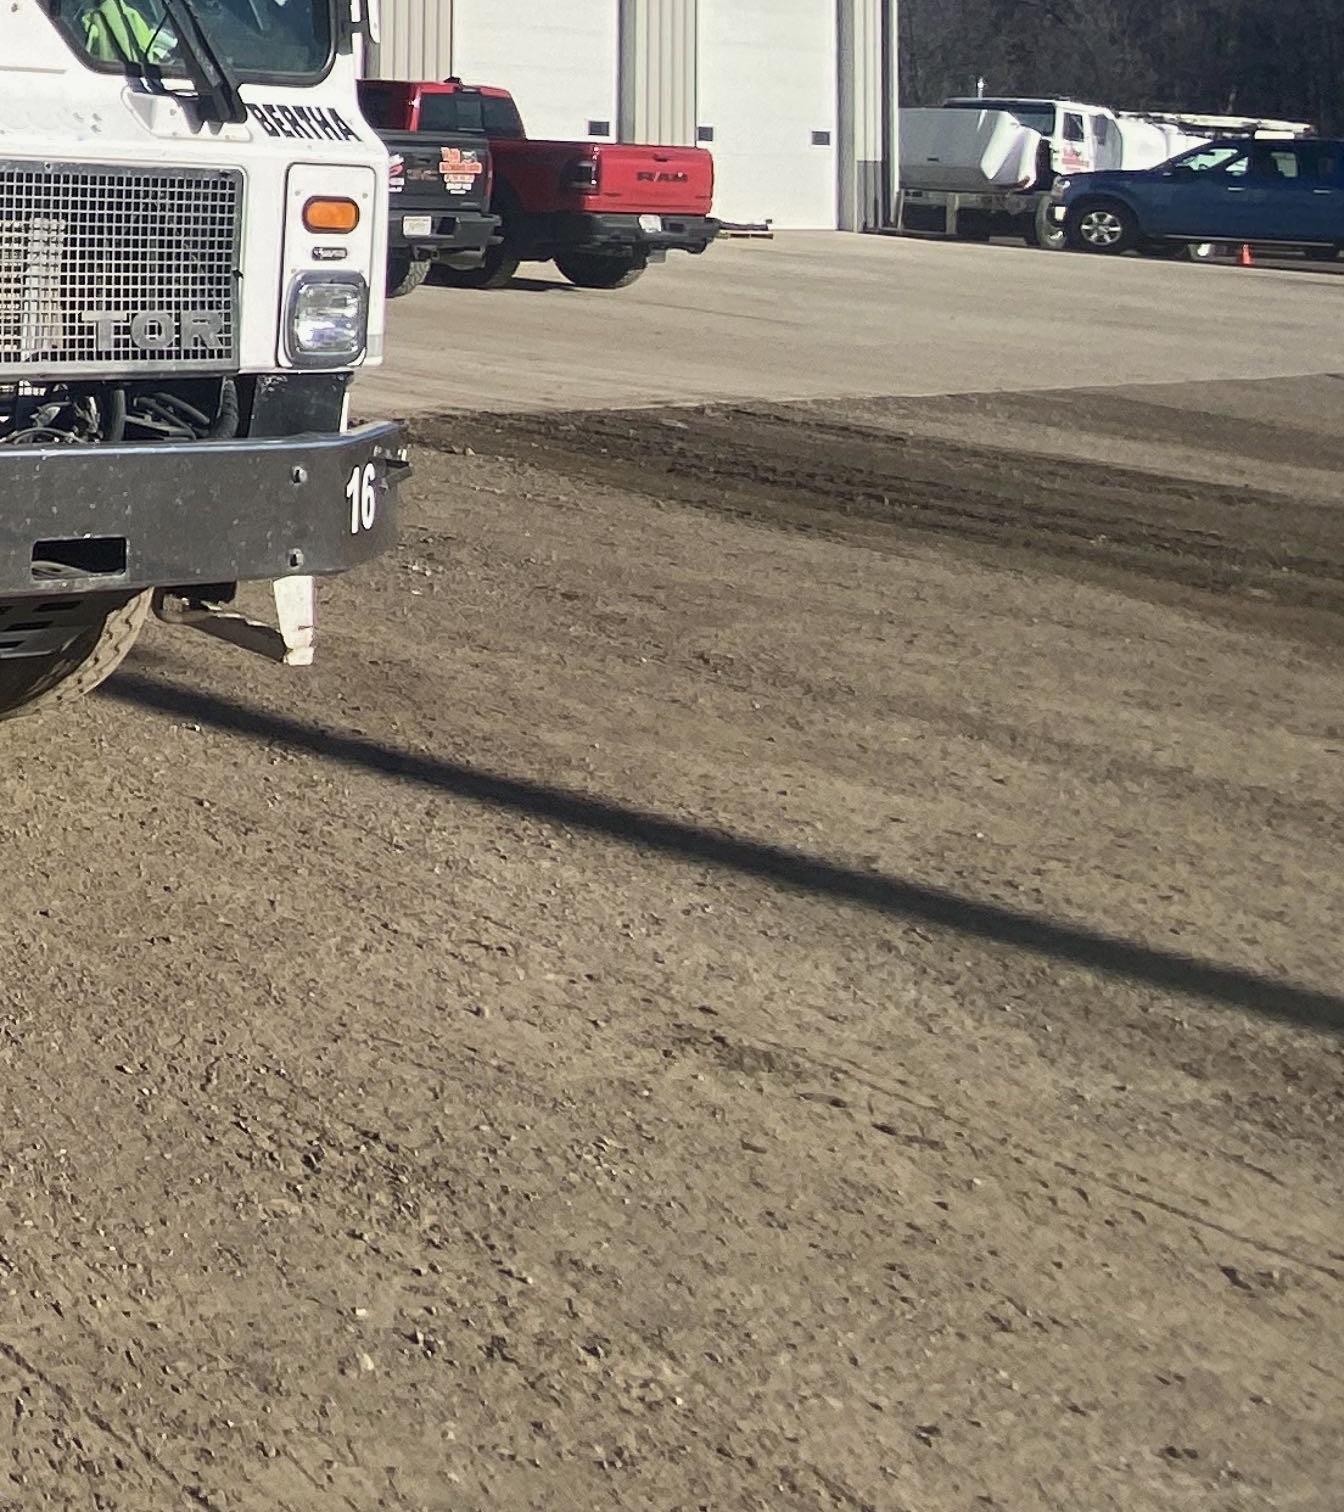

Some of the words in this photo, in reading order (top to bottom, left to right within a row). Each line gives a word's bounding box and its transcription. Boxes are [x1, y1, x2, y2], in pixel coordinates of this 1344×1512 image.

[245, 103, 362, 142] BERTHA
[636, 172, 688, 182] RAM
[81, 311, 223, 350] TOR
[346, 463, 375, 534] 16
